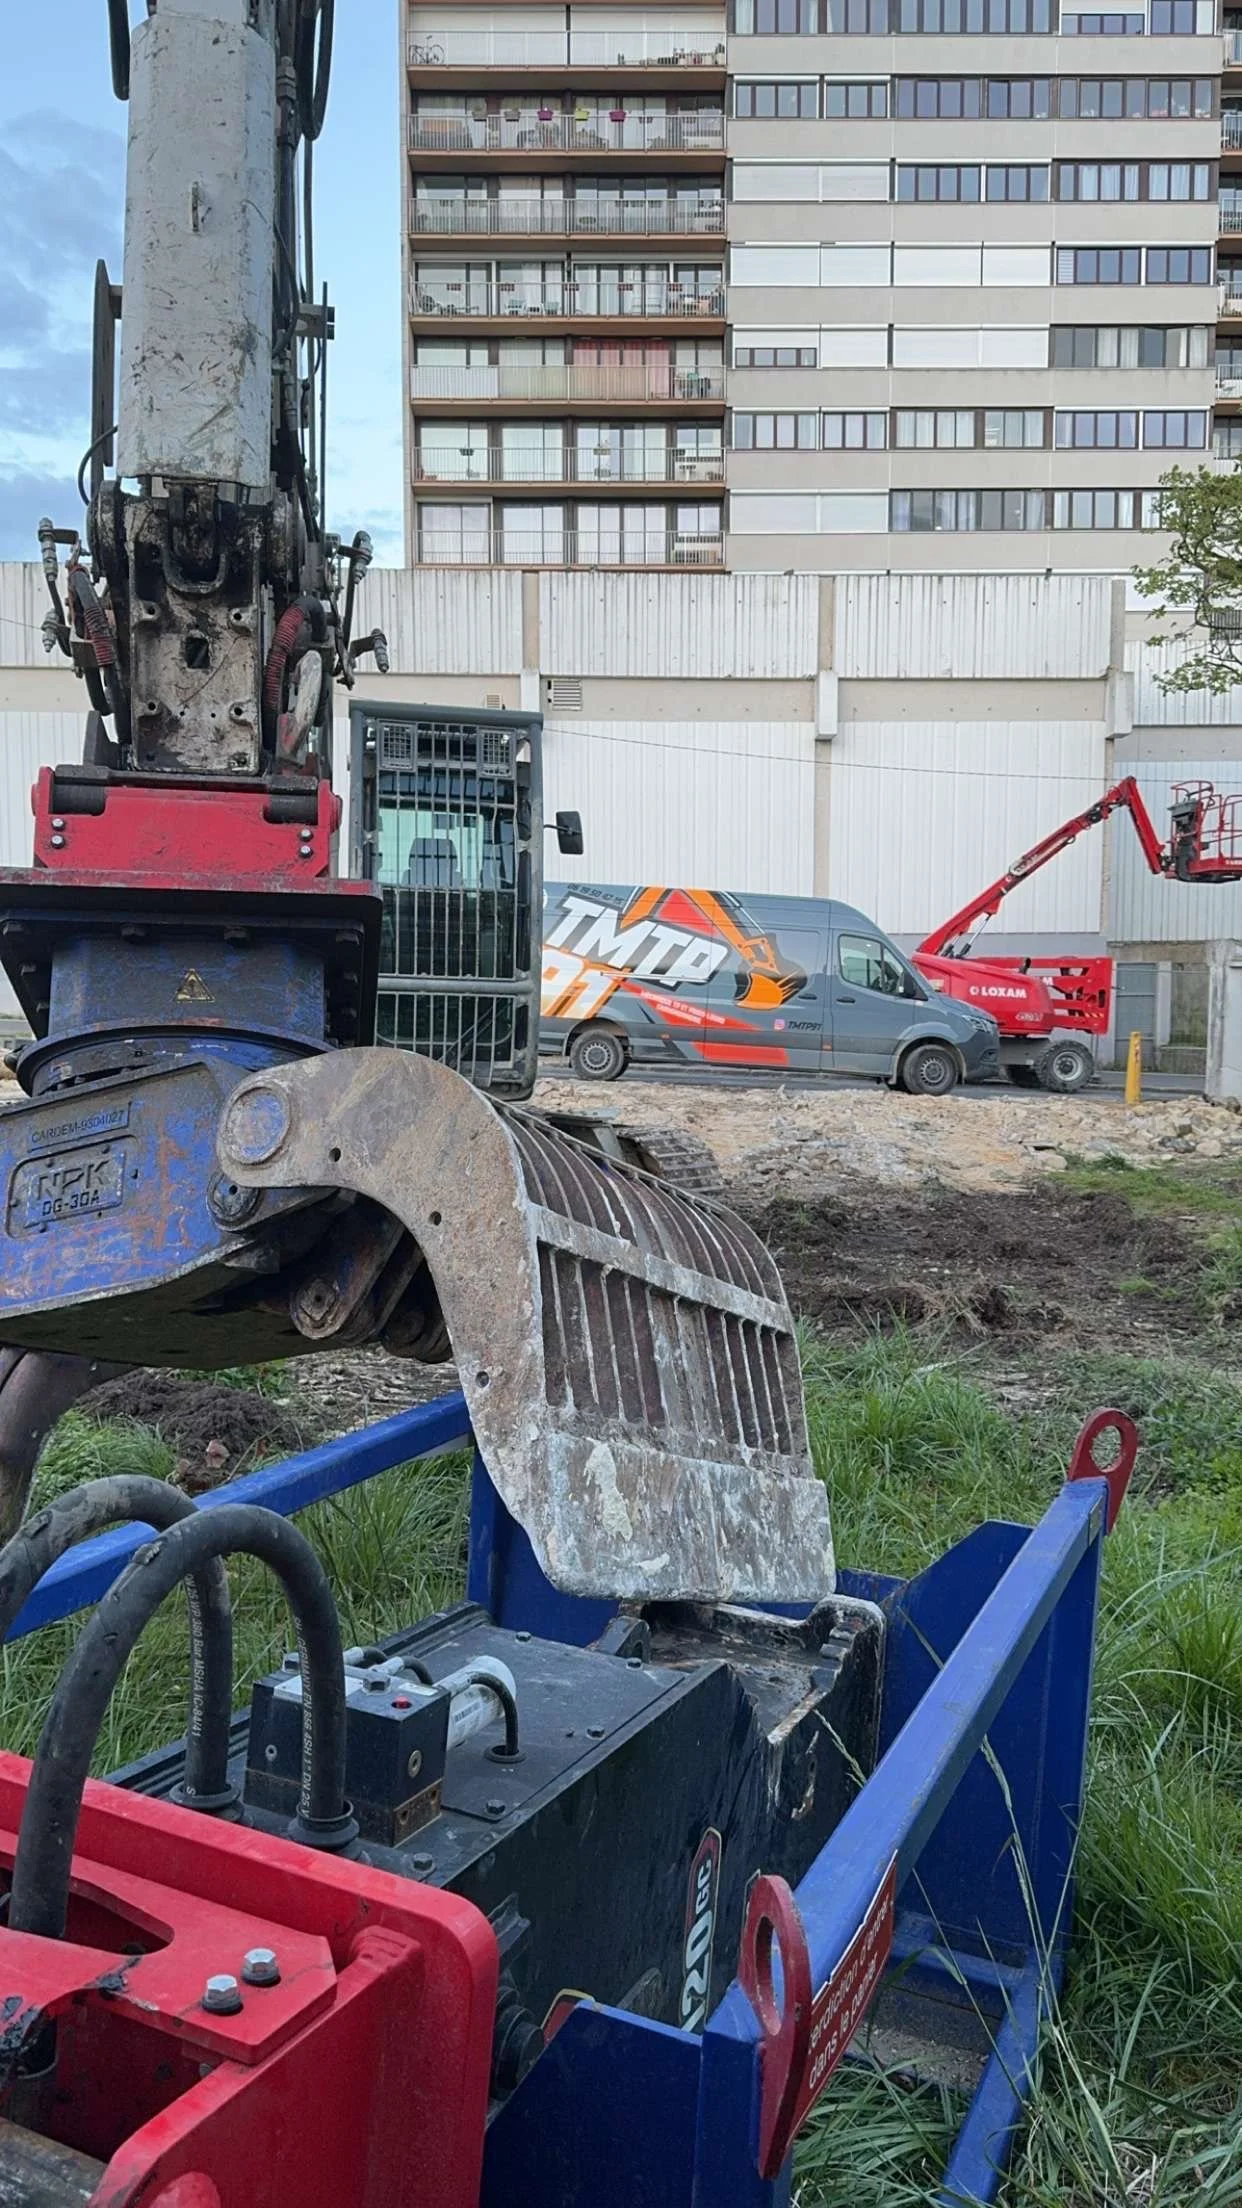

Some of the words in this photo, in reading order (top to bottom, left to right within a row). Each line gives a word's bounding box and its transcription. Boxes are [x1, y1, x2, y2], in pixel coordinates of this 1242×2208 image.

[546, 895, 728, 987] TMTP
[981, 986, 1027, 999] LOXAM
[38, 1160, 110, 1200] NPK
[193, 1660, 205, 1691] MSHA
[808, 1960, 859, 2055] erdiction
[808, 2031, 838, 2089] dans
